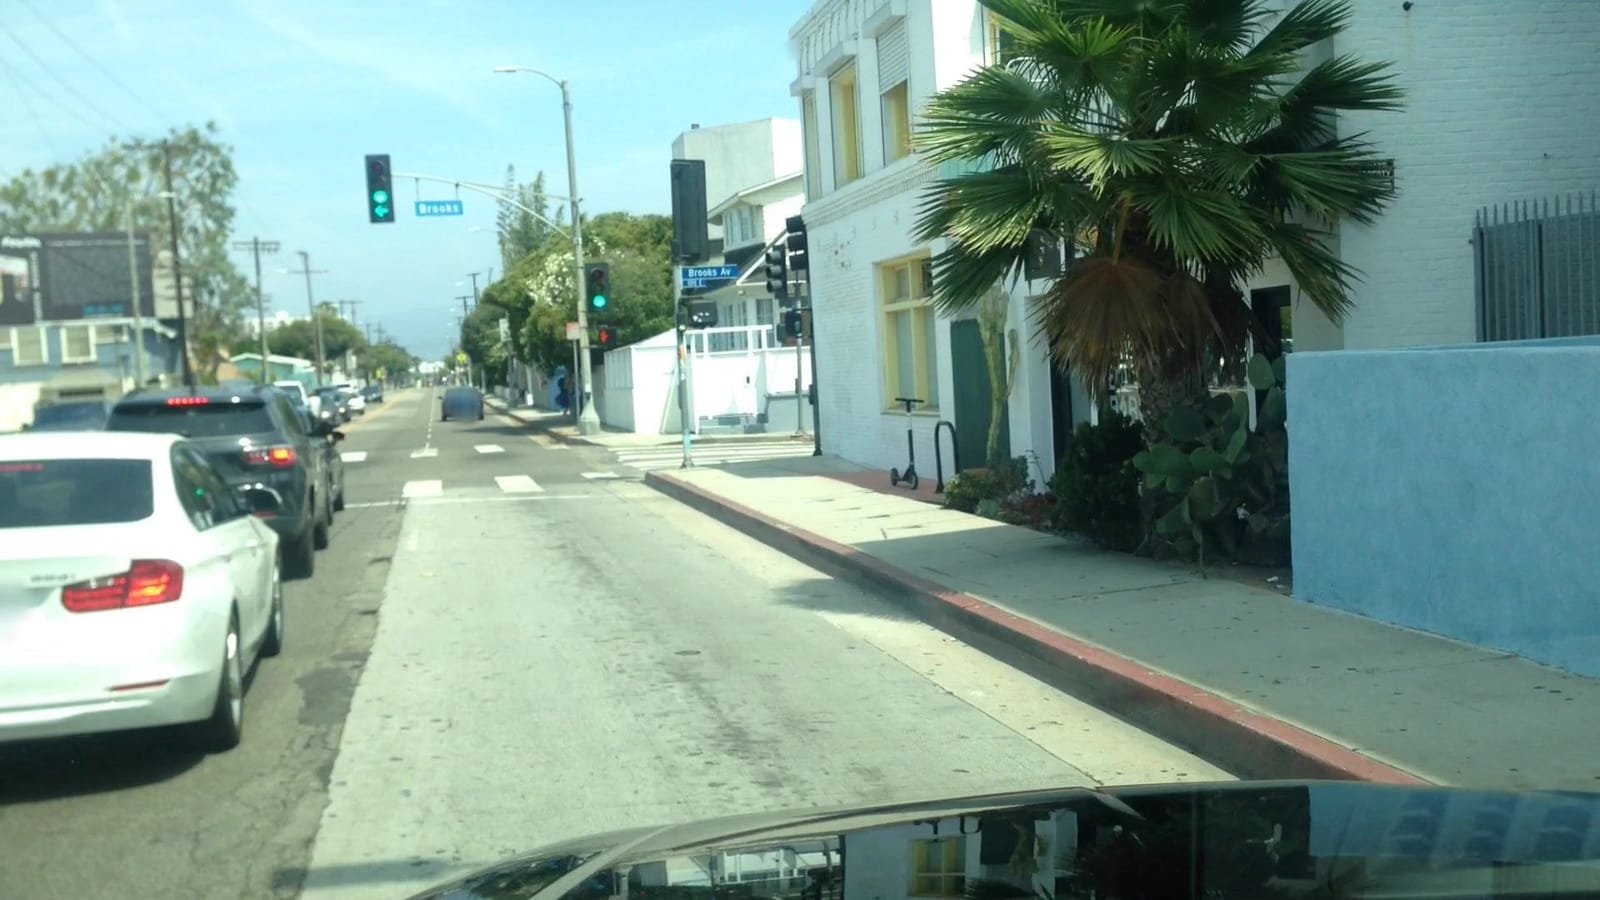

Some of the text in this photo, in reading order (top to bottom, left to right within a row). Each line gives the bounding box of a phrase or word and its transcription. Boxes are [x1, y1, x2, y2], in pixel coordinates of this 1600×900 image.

[418, 203, 459, 214] Brooks
[688, 267, 731, 278] Brooks Av
